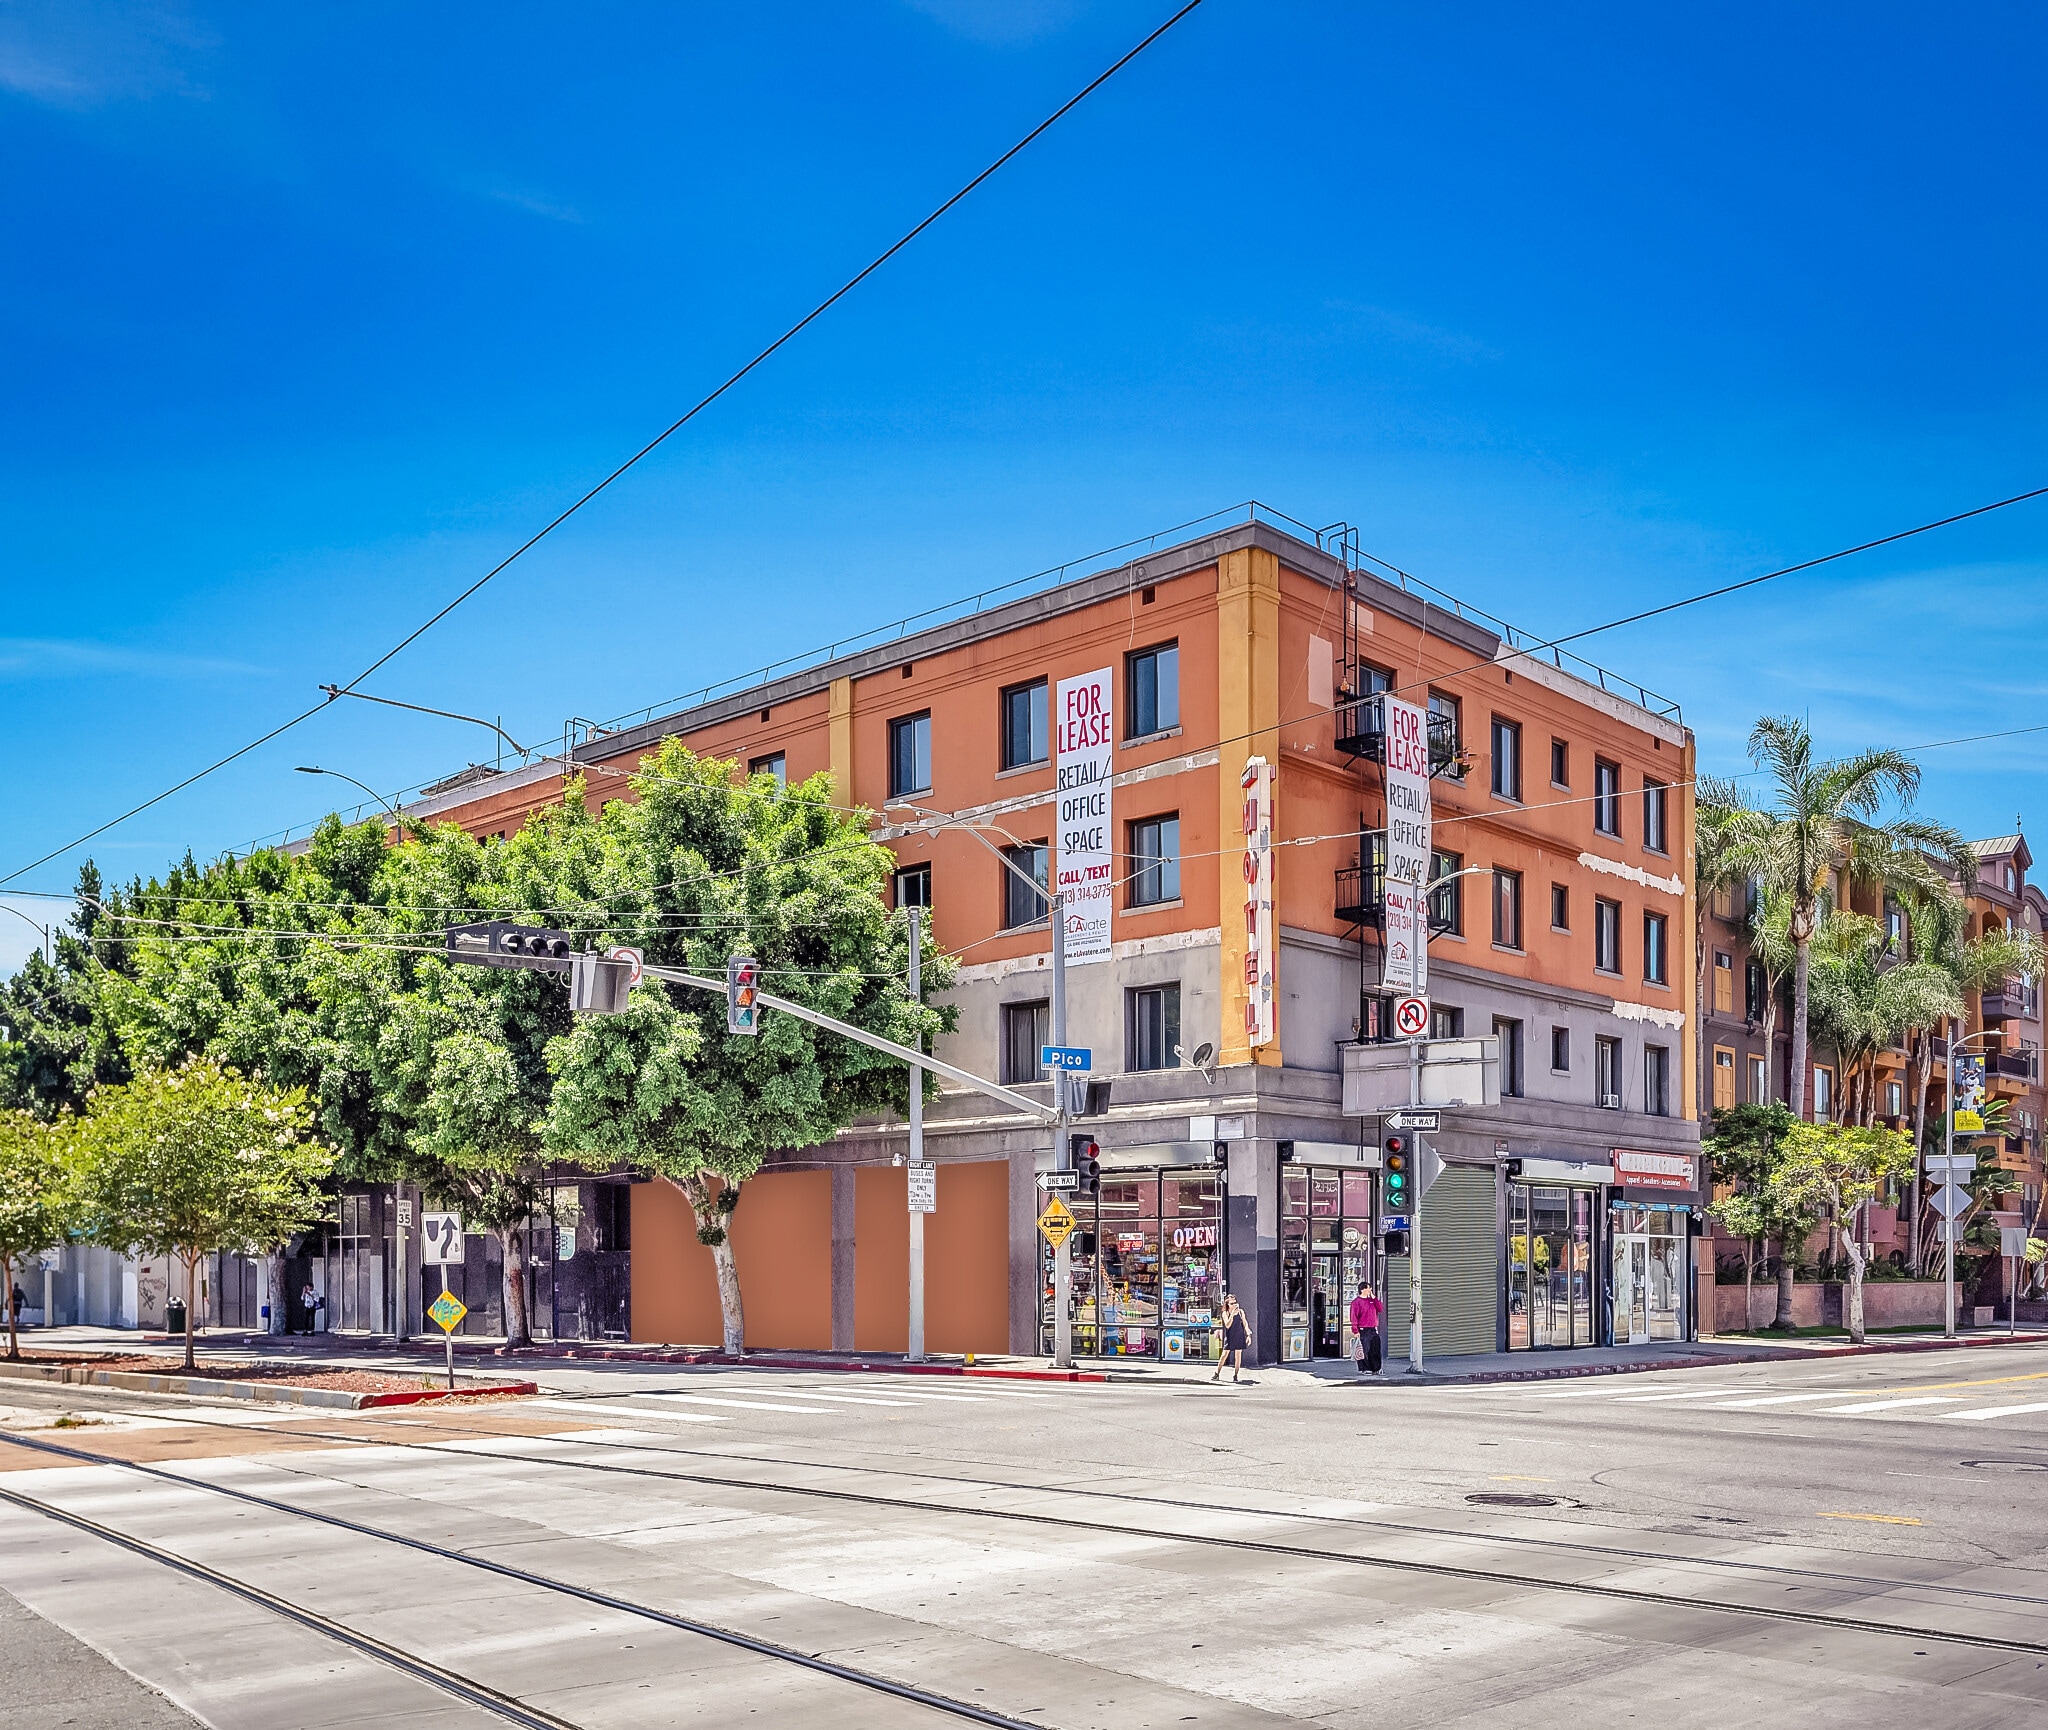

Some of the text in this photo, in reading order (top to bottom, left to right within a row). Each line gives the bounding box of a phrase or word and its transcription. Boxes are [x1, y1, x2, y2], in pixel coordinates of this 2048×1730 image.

[1067, 684, 1101, 721] FOR
[1058, 712, 1110, 754] LEASE
[1393, 706, 1420, 745] FOR
[1387, 735, 1427, 779] LEASE
[1062, 792, 1105, 822] OFFICE
[1064, 827, 1103, 855] SPACE
[1394, 819, 1426, 849] OFFICE
[1058, 864, 1111, 886] CALL/TEXT
[1052, 1052, 1082, 1066] Pico
[1402, 1118, 1433, 1126] ONE WAY
[922, 1162, 934, 1170] LANE
[1048, 1177, 1060, 1185] ONE
[398, 1213, 411, 1224] 35
[1380, 1217, 1396, 1225] Flower
[1173, 1226, 1216, 1248] OPEN
